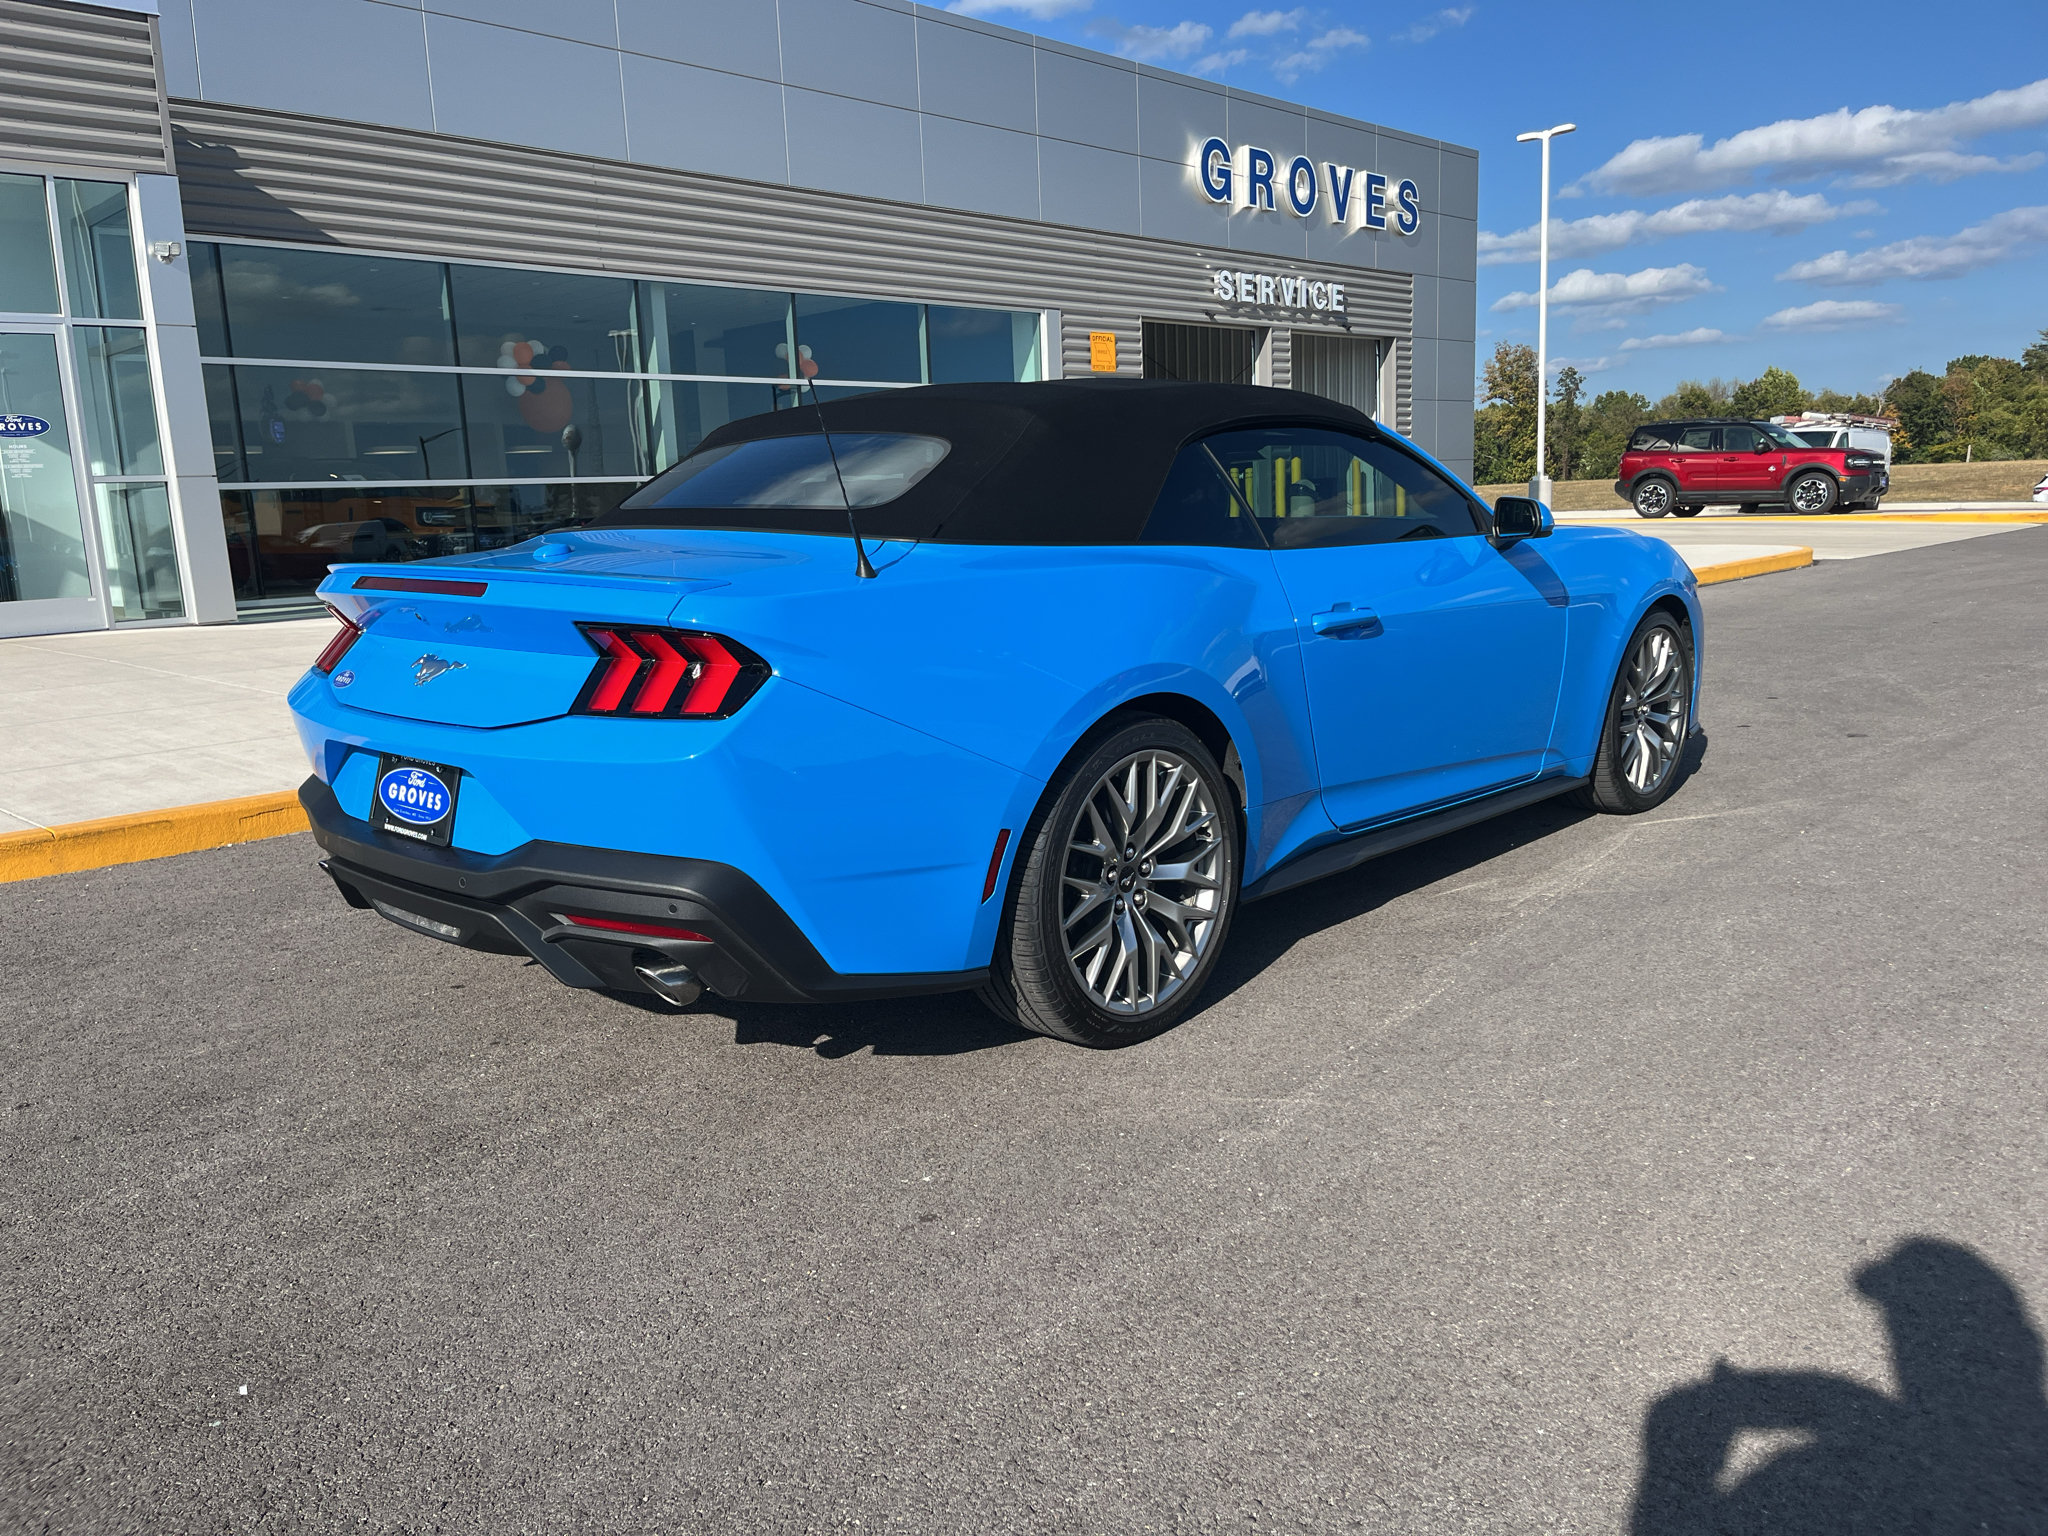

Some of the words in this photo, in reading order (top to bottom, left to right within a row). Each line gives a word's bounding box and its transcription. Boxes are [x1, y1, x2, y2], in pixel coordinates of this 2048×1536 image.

[1196, 136, 1420, 236] GROVES
[1214, 269, 1345, 313] SERVICE
[0, 423, 42, 431] ROVES
[407, 771, 427, 788] Ford
[388, 782, 442, 811] GROVES
